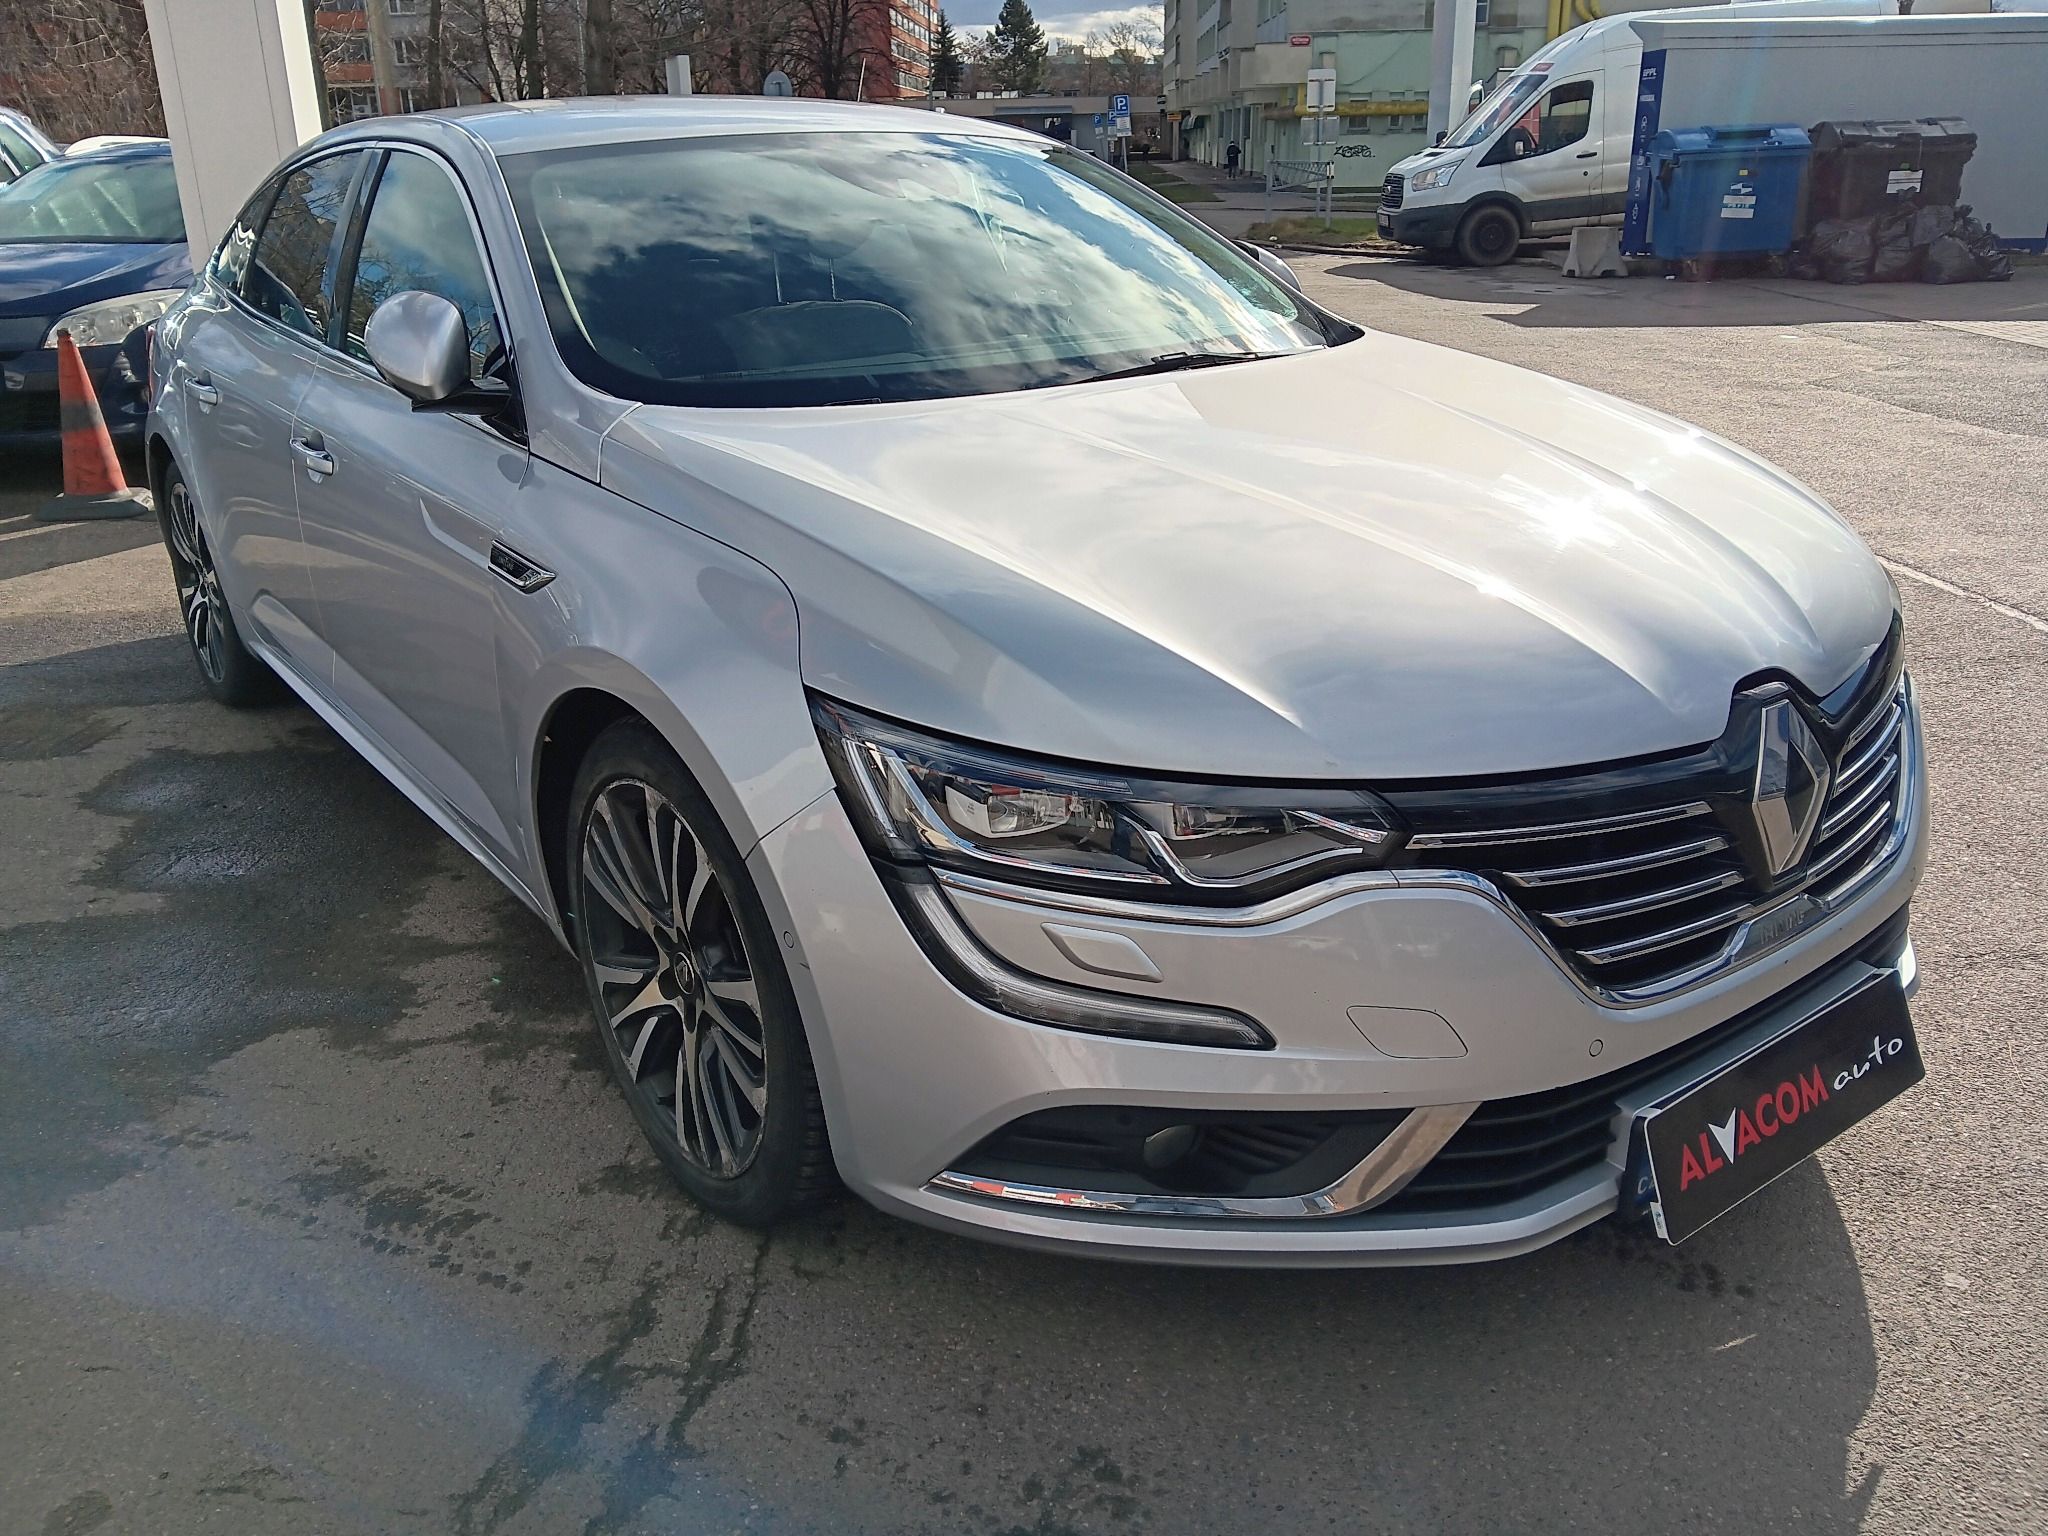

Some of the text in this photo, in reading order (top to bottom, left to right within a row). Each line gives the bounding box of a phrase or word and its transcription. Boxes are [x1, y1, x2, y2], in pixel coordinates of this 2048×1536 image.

[1118, 98, 1126, 110] P
[1679, 1035, 1904, 1192] ALVACOM auto
